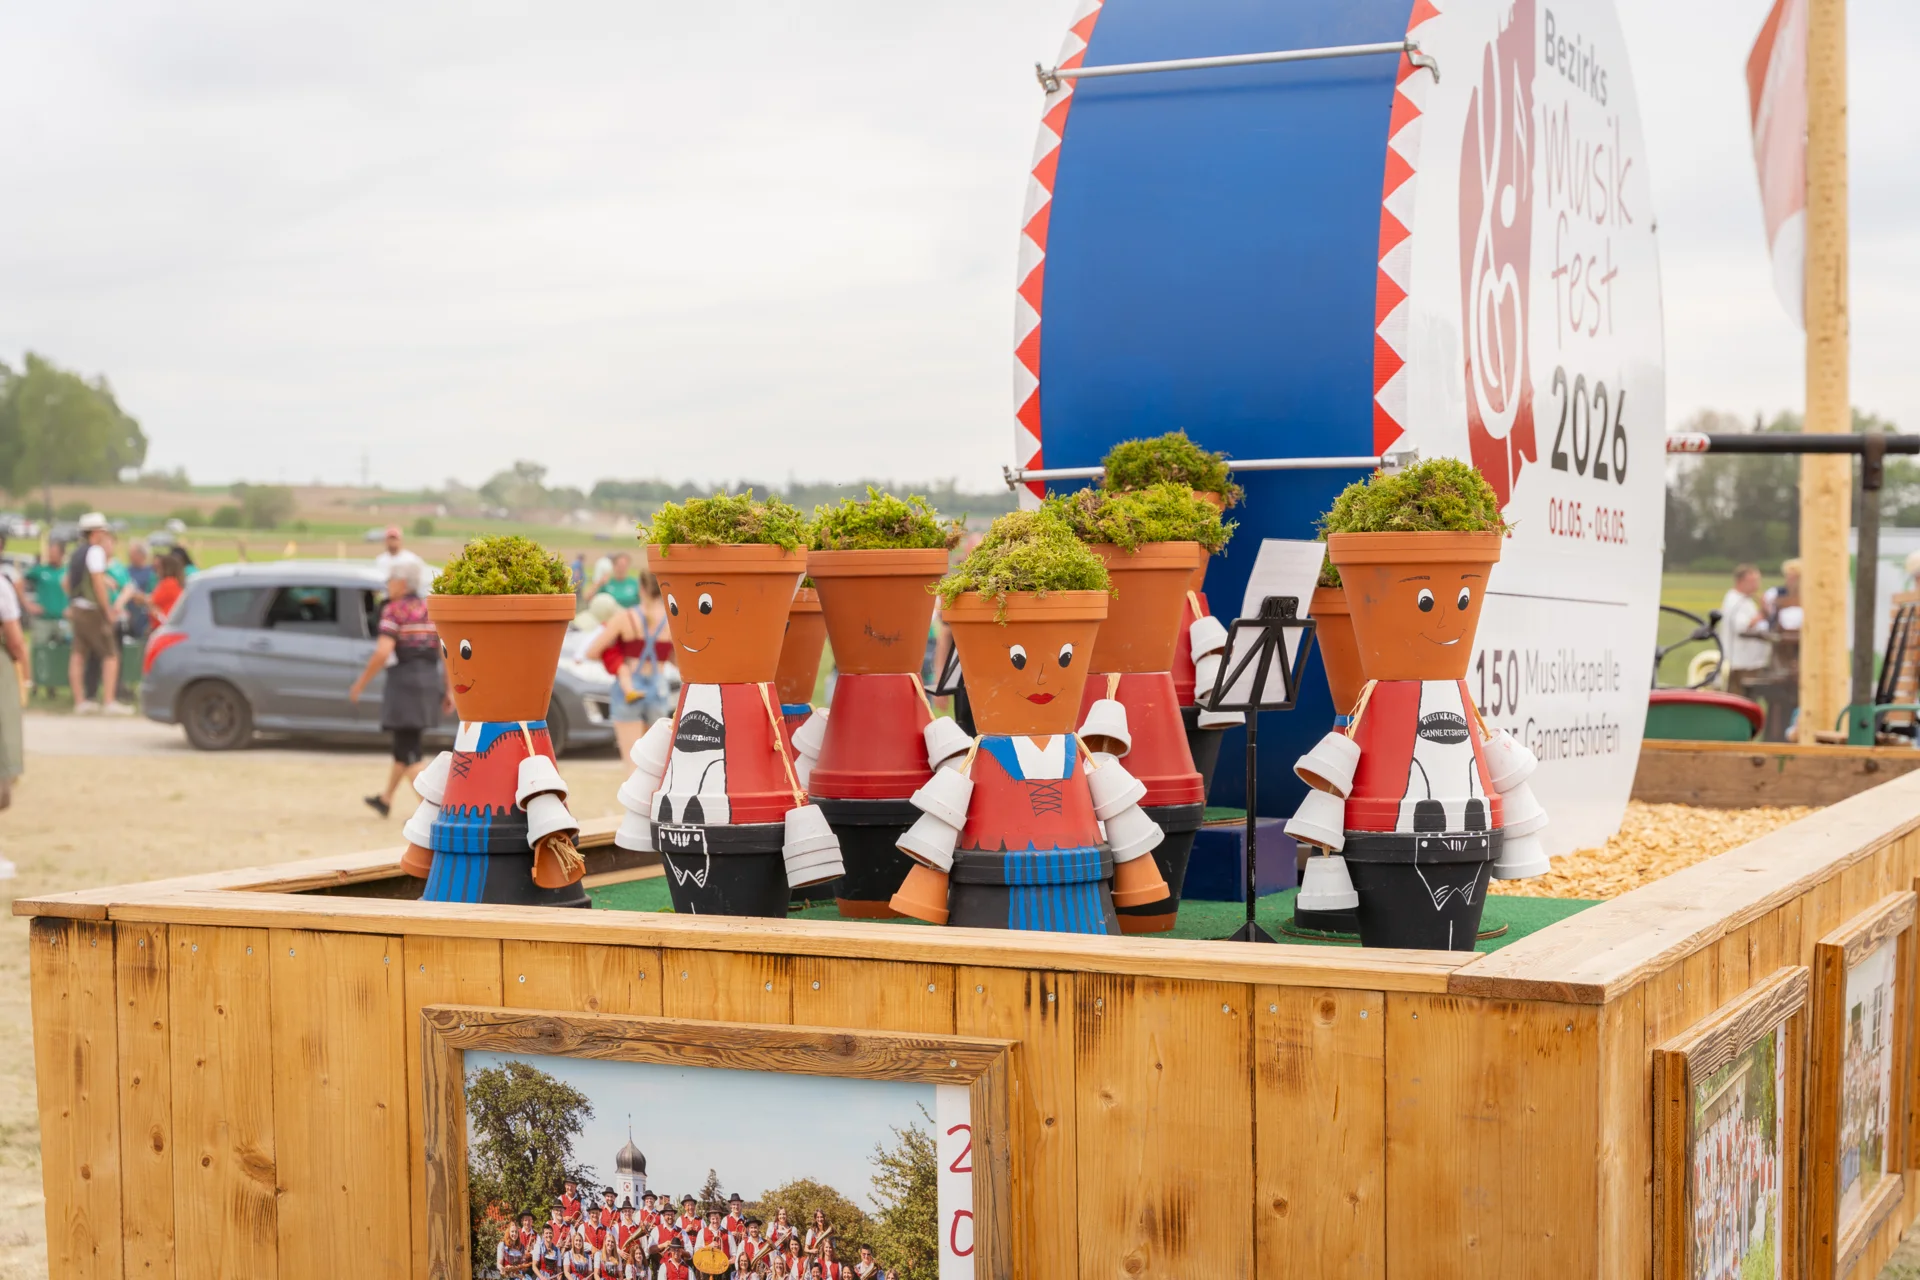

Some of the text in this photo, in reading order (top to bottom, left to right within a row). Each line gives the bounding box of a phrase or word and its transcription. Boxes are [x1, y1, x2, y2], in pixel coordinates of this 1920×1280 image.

[1545, 7, 1607, 107] Bezirks
[1543, 99, 1633, 228] Musik
[1551, 209, 1618, 351] fest
[1551, 365, 1627, 485] 2026
[1476, 649, 1519, 718] 150
[1525, 649, 1620, 702] Musikkapelle
[1525, 712, 1620, 762] Gannertshofen
